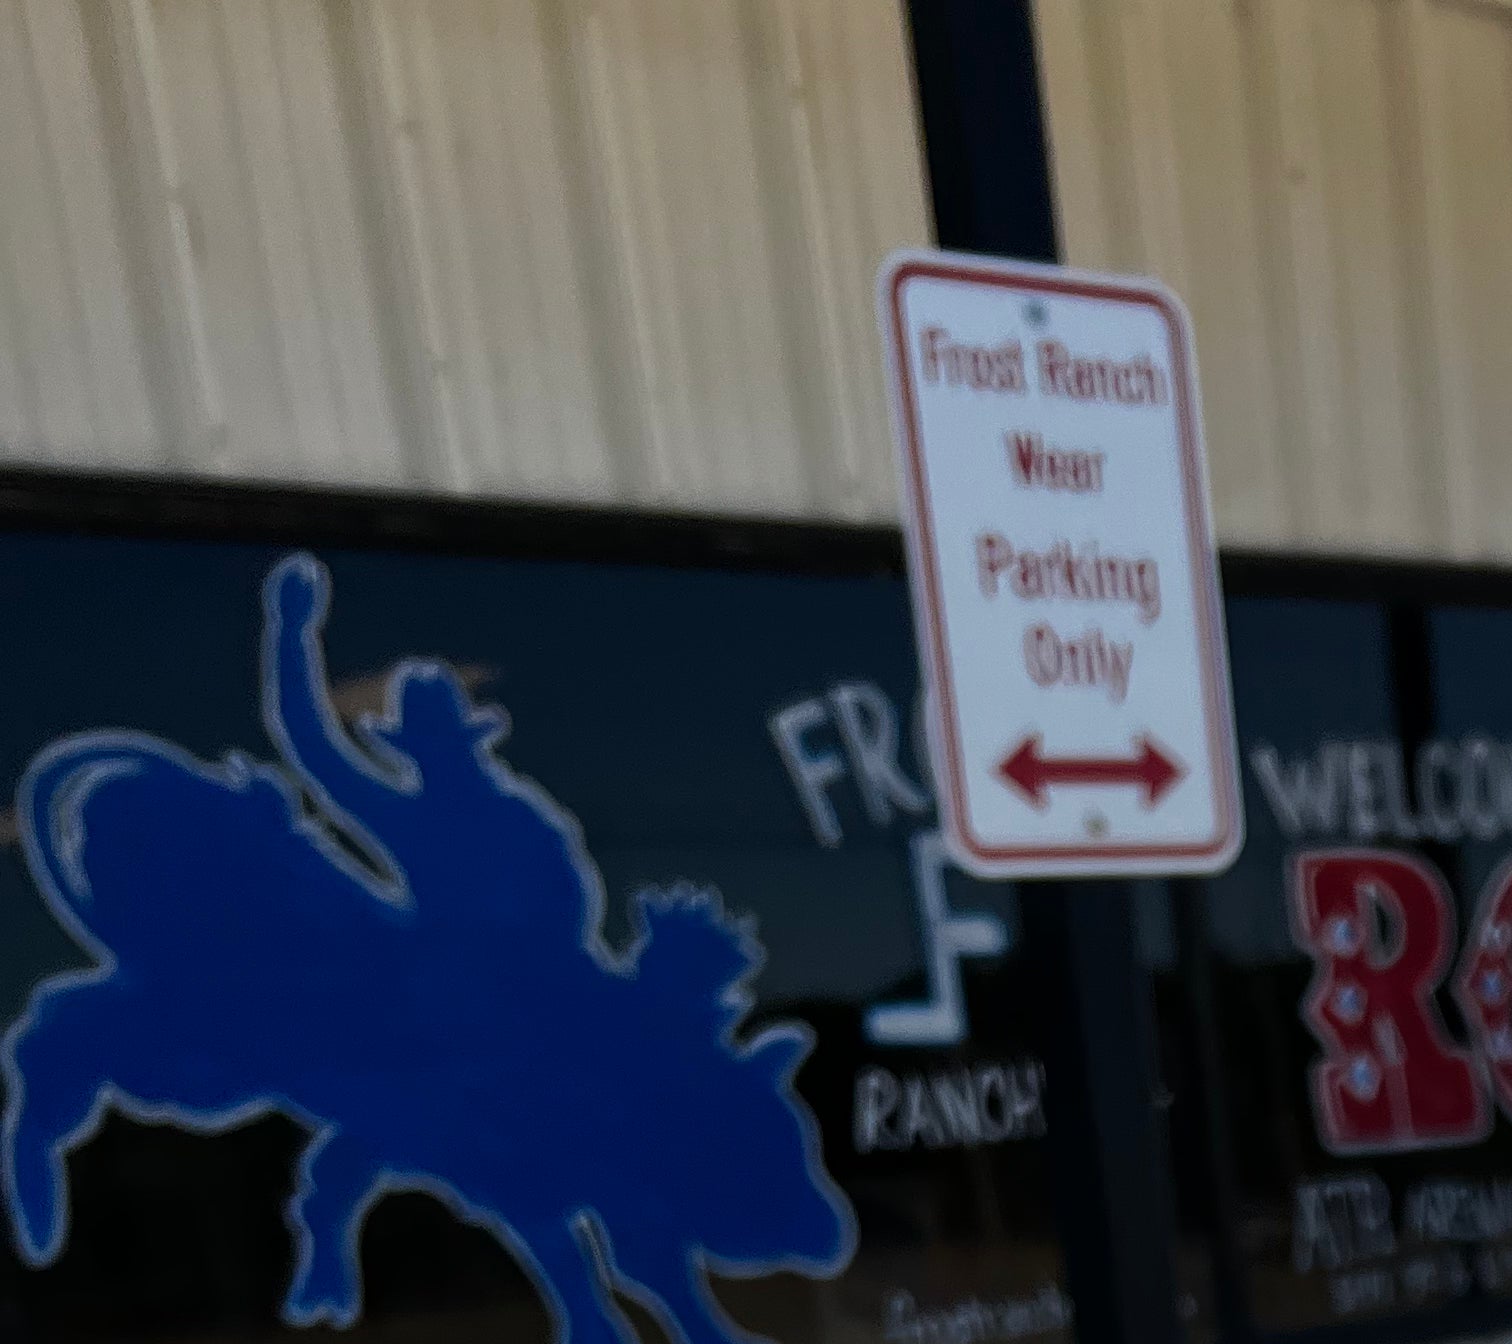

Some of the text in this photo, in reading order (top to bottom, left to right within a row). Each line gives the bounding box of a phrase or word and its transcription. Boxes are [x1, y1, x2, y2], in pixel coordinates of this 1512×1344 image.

[920, 326, 1168, 405] Frost Ranch
[1006, 430, 1108, 494] Wear
[977, 532, 1162, 625] Parking
[1023, 623, 1134, 704] Only
[766, 681, 930, 848] FR
[853, 1060, 1048, 1154] RANCH
